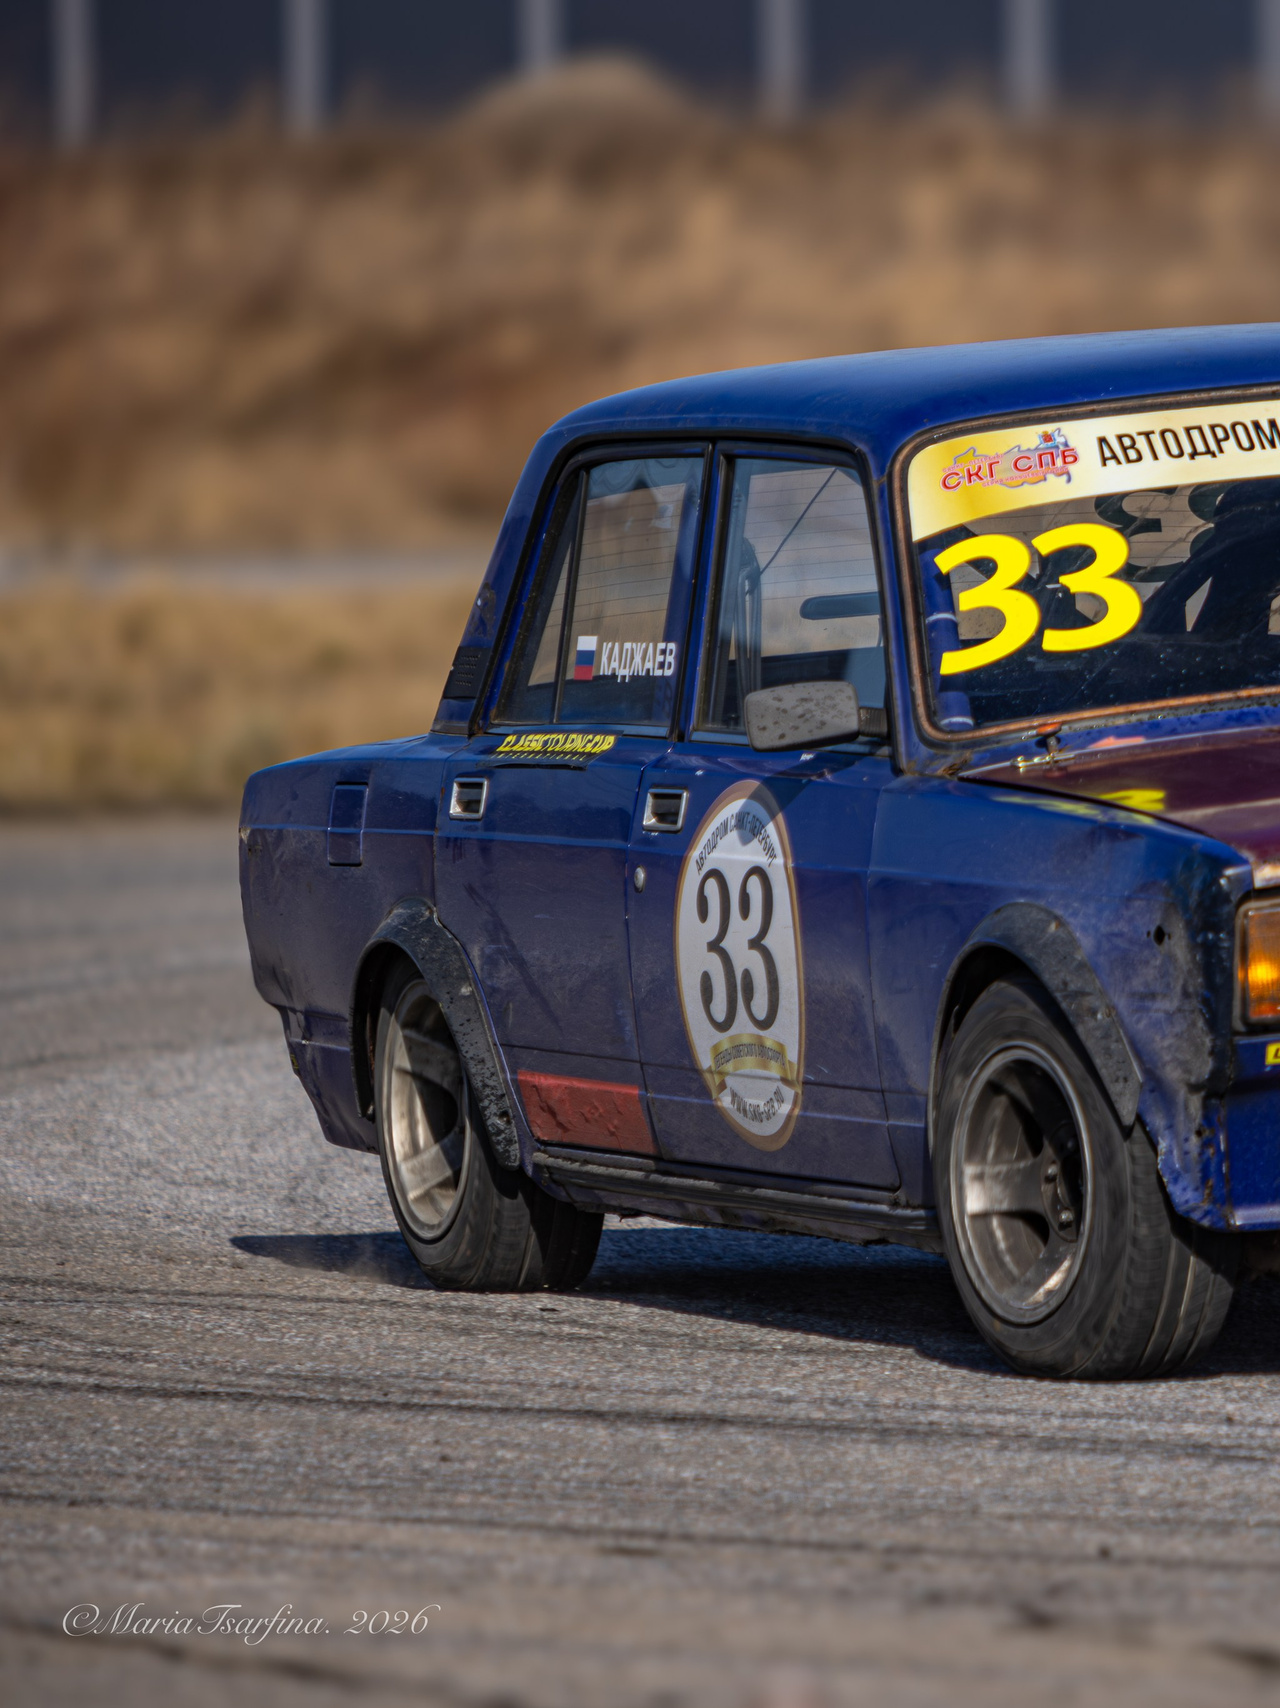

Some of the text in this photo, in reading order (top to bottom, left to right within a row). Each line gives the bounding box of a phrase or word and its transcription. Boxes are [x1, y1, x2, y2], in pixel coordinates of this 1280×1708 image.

[941, 448, 1079, 491] СКГ СПБ
[933, 522, 1142, 675] 33
[600, 641, 676, 683] КАДЖАЕВ
[695, 811, 777, 876] АВТОДРОМ САНКТ-ПЕТЕРБУРГ
[696, 866, 780, 1033] 33
